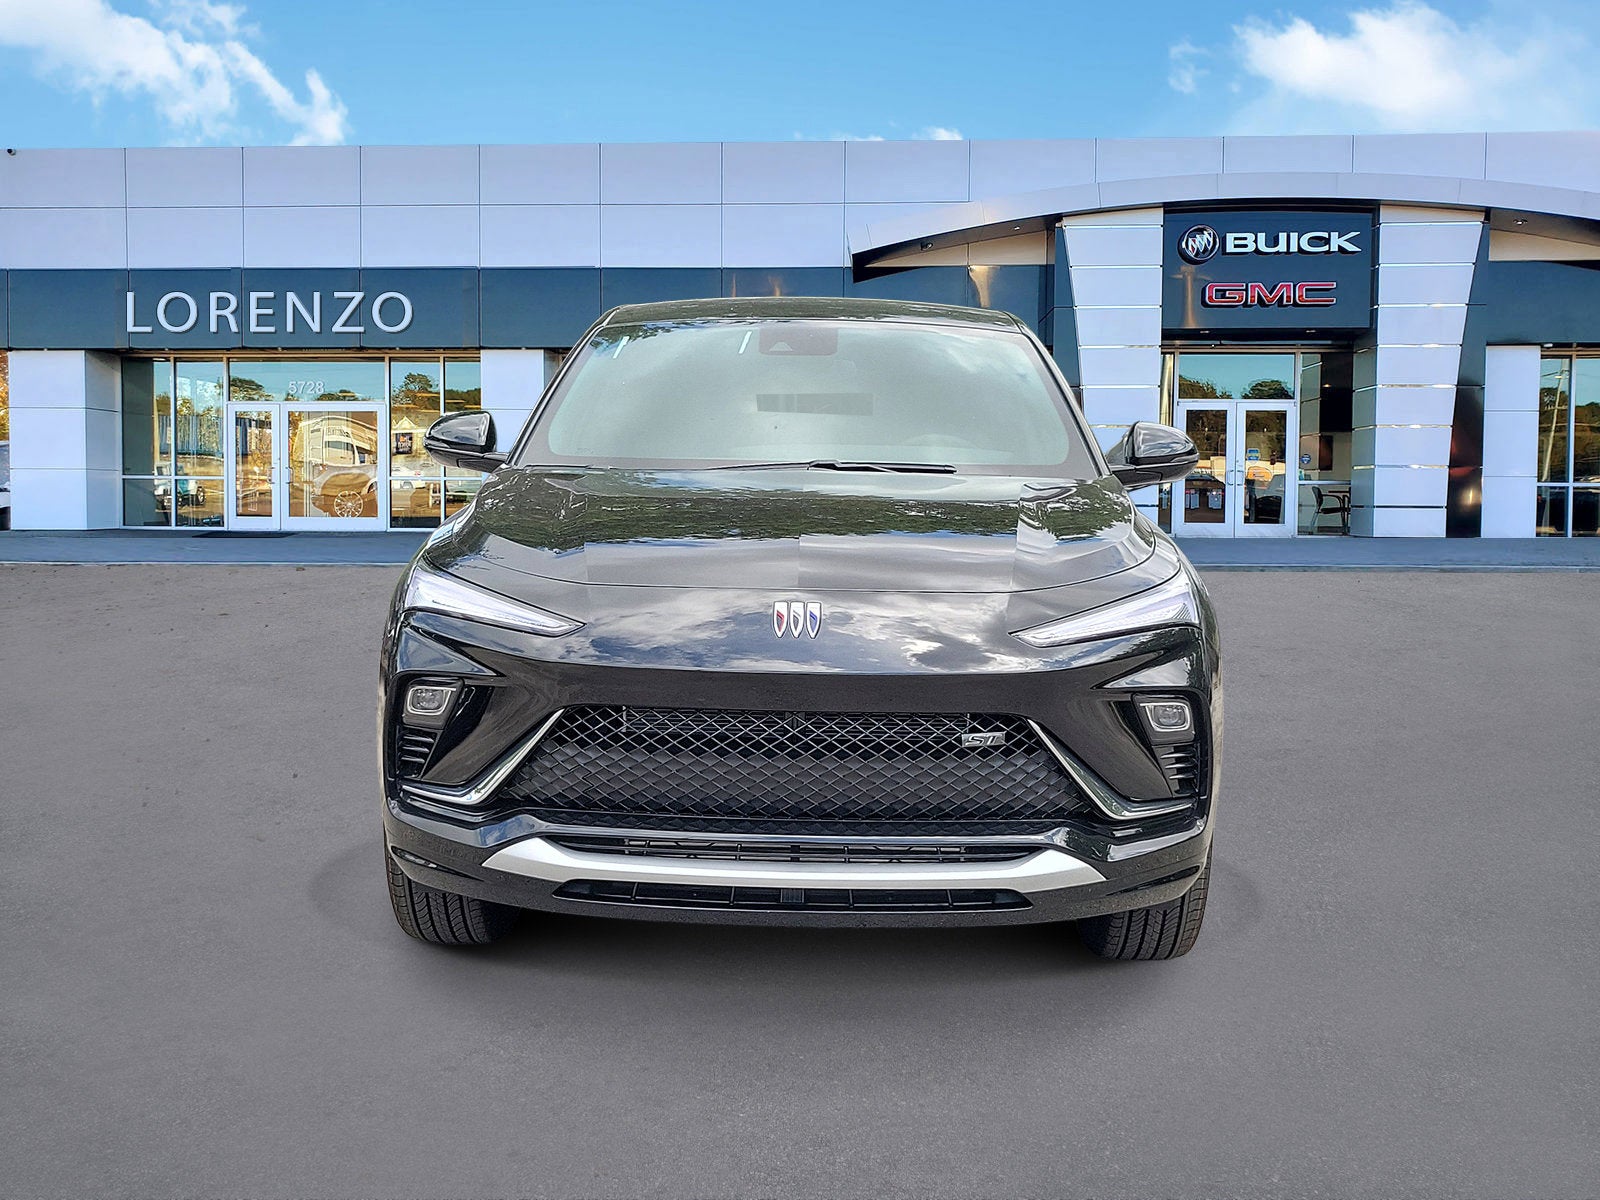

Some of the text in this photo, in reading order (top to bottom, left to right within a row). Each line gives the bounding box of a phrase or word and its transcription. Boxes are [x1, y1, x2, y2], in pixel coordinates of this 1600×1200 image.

[1225, 231, 1362, 253] BUICK
[1205, 281, 1337, 306] GMC
[126, 291, 414, 333] LORENZO
[288, 381, 325, 394] 5728
